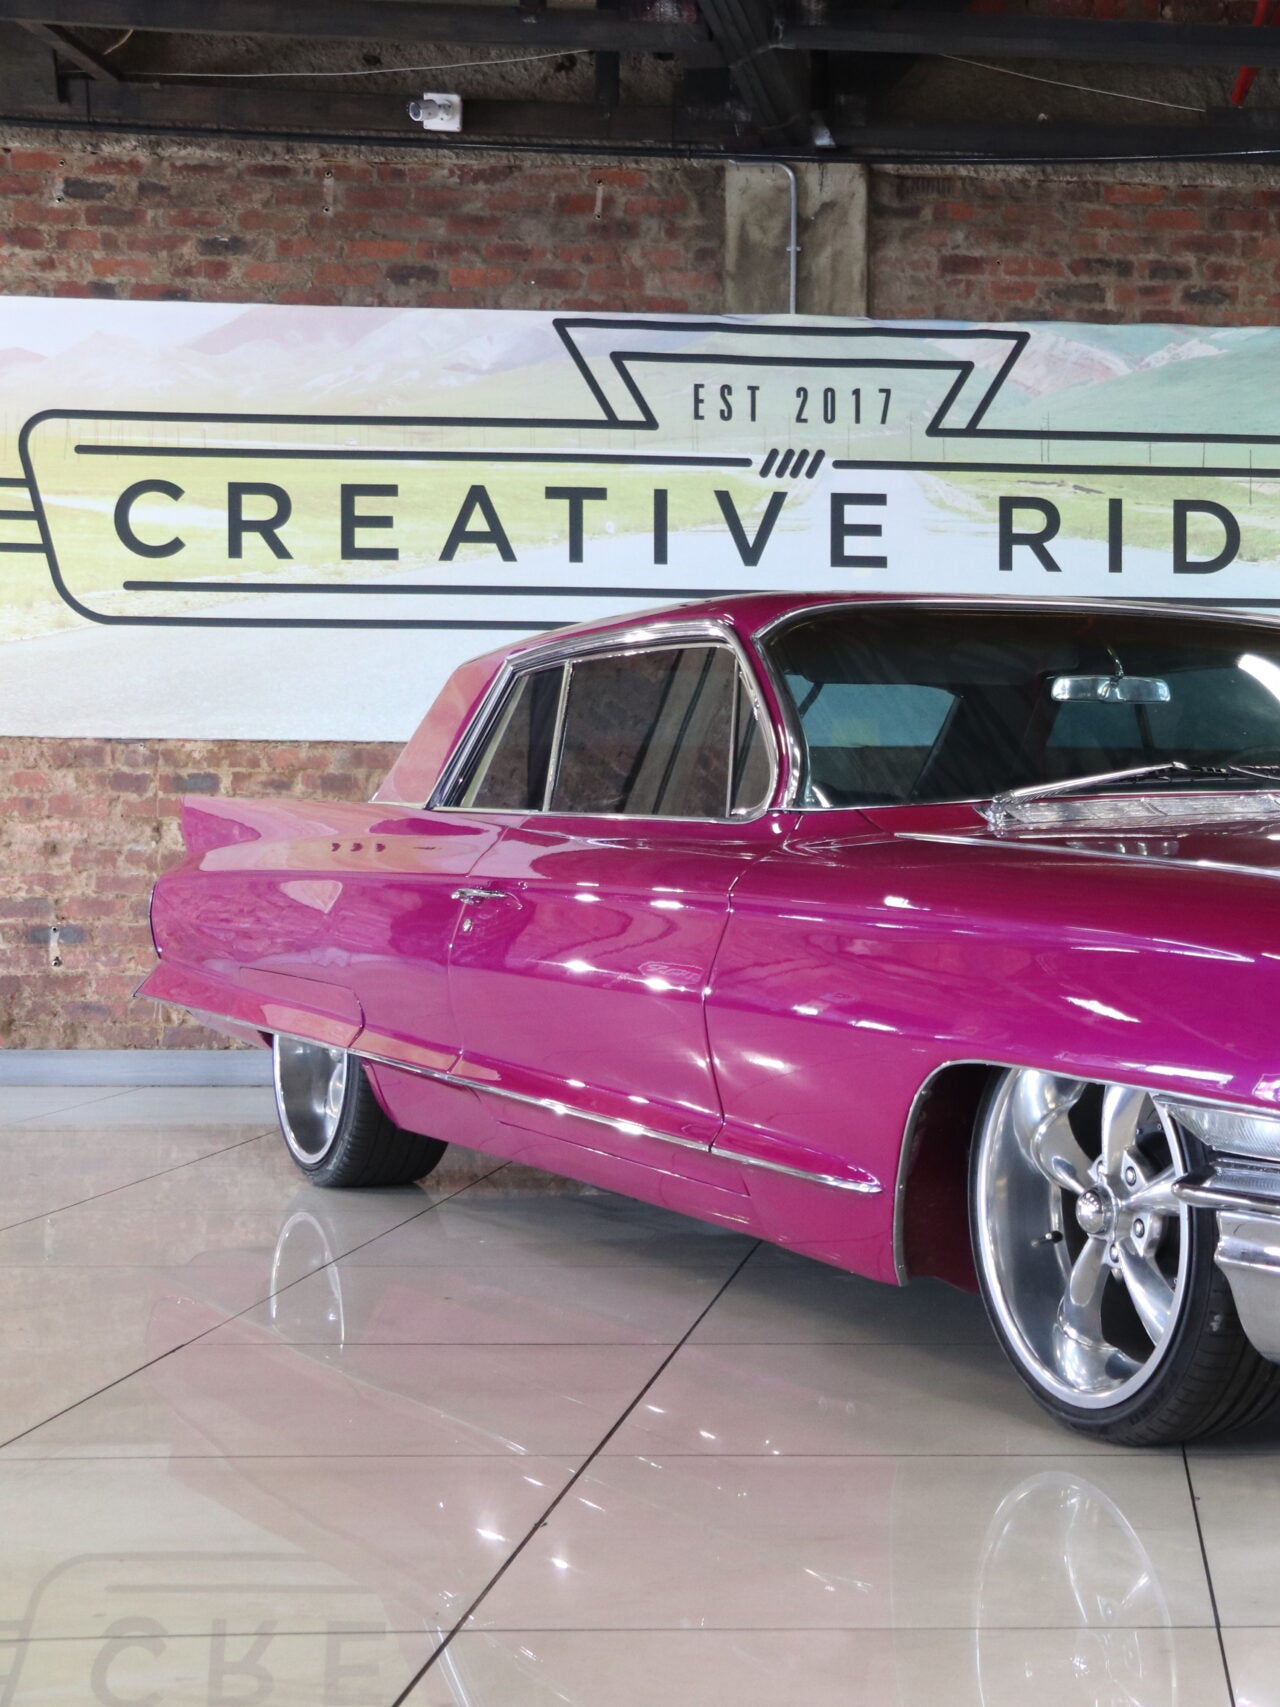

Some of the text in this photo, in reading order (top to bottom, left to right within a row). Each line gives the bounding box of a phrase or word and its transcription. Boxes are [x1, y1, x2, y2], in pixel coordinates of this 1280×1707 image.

[693, 383, 892, 425] EST 2017
[114, 479, 888, 568] CREATIVE
